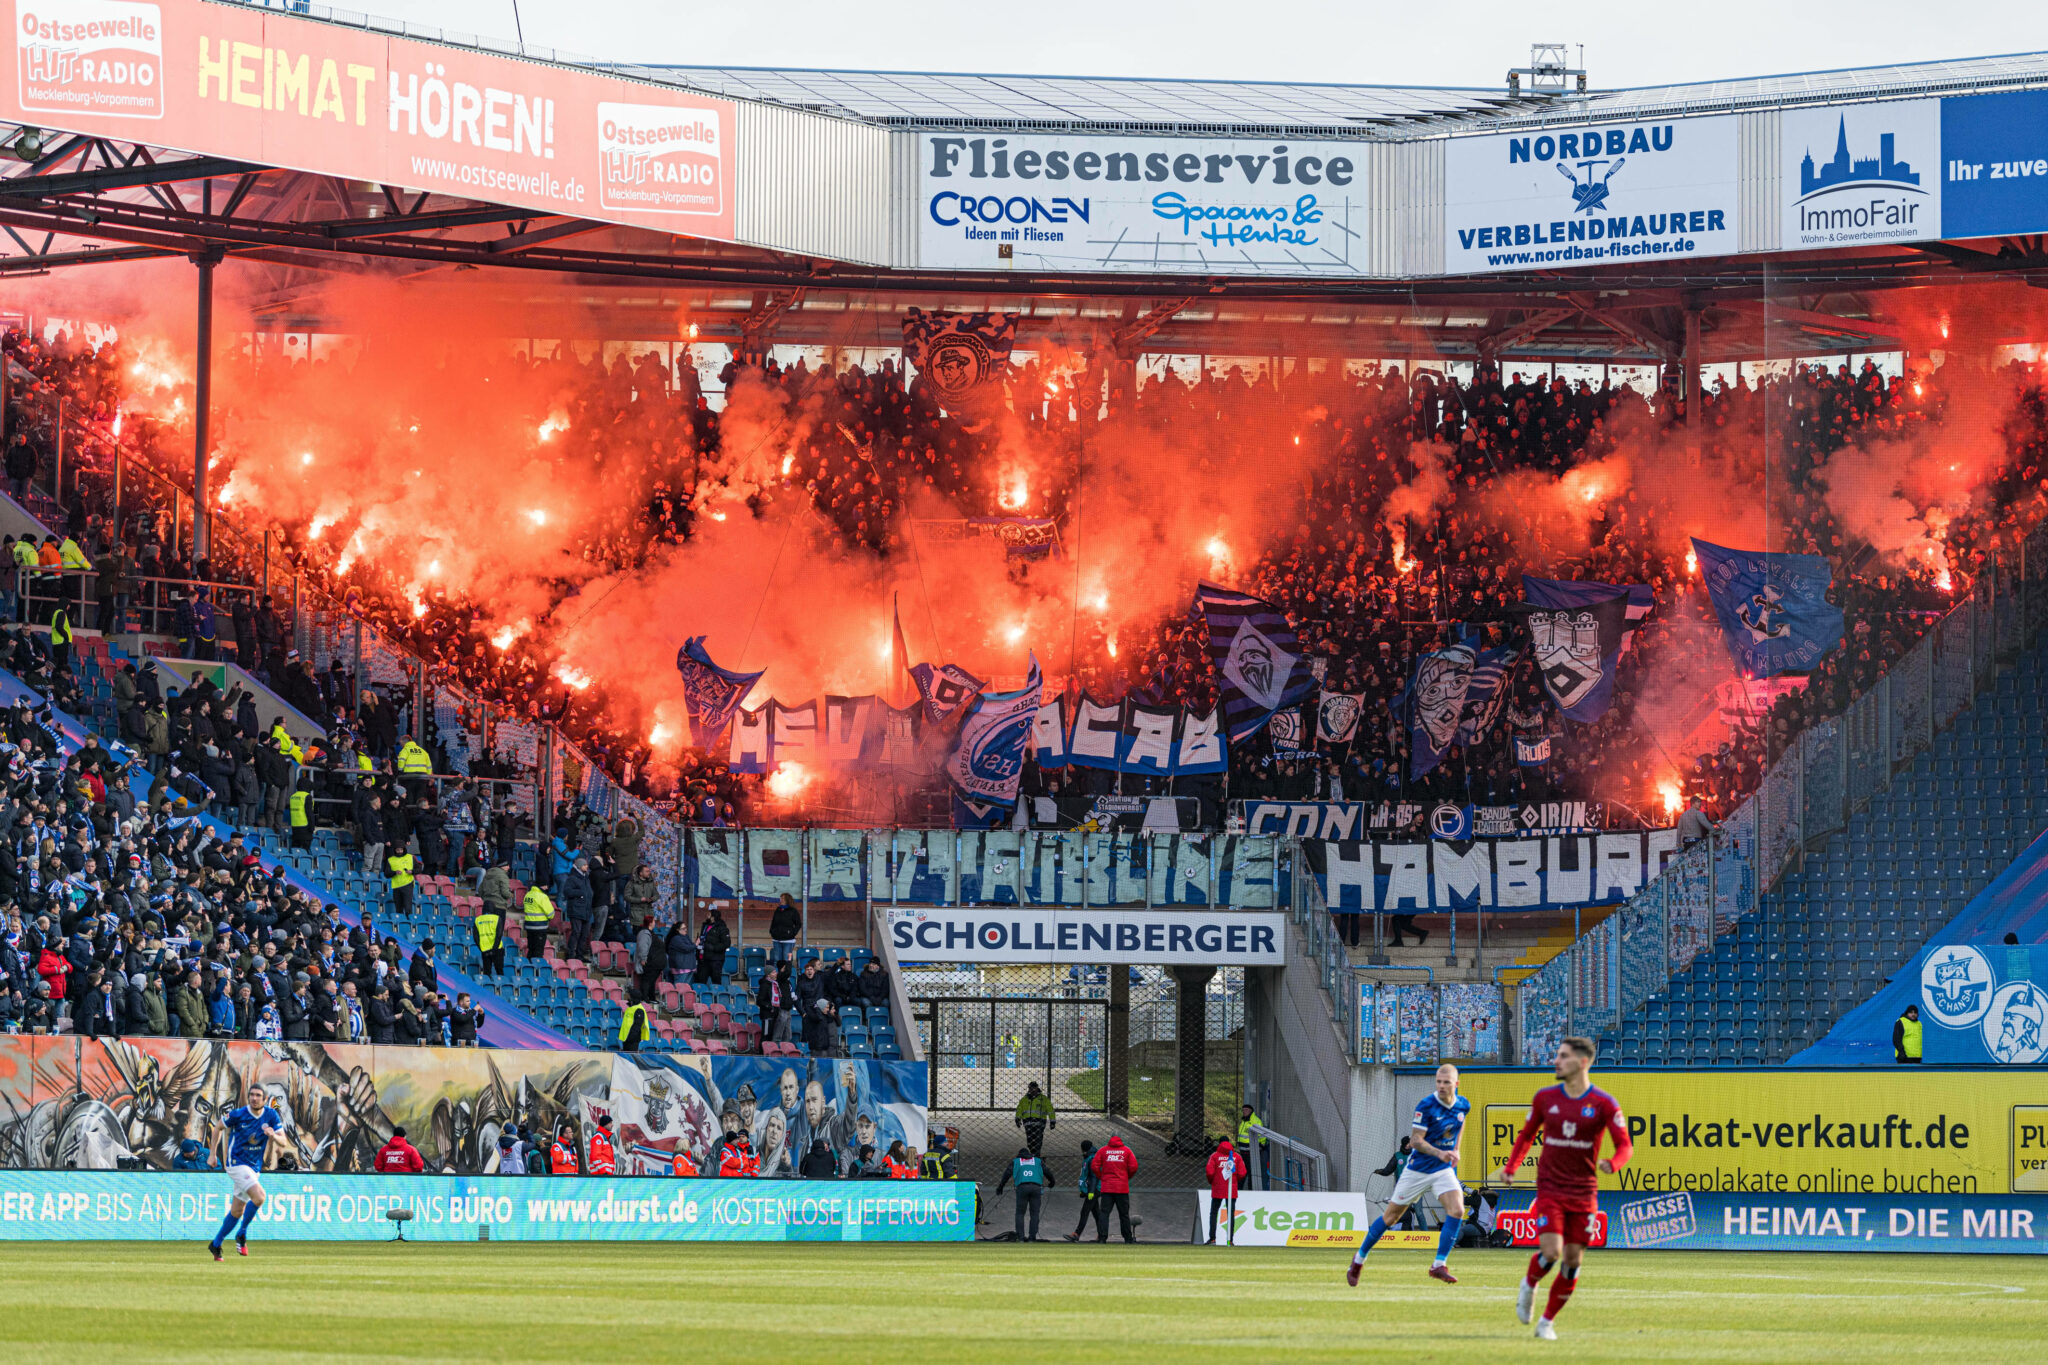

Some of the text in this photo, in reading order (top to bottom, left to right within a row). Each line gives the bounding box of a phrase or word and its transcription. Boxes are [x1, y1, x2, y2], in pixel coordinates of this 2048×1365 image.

[22, 12, 155, 41] Ostseewelle
[27, 43, 154, 86] HIT-RADIO
[28, 86, 154, 107] Mecklenburg-Vorpommern
[198, 35, 554, 159] HEIMAT HÖREN!
[602, 119, 715, 146] Ostseewelle
[1509, 125, 1673, 164] NORDBAU
[607, 147, 714, 185] HIT-RADIO
[929, 136, 1354, 186] Fliesenservice
[1948, 159, 1984, 182] Ihr
[411, 155, 585, 203] www.ostseewelle.de
[608, 187, 714, 205] Mecklenburg-Vorpommern
[930, 190, 1090, 227] CROONEN
[1152, 191, 1323, 236] Spaans &
[1458, 209, 1727, 250] VERBLENDMAURER
[1800, 197, 1920, 232] ImmoFair
[965, 226, 1064, 242] Ideen mit Fliesen
[1200, 221, 1319, 248] Henke
[1801, 228, 1918, 244] Wohn- & Gewerbeimmobilien
[1487, 238, 1695, 266] www.nordbau-fischer.de
[1541, 801, 1586, 828] IRON
[893, 920, 1276, 953] SCHOLLENBERGER
[1628, 1114, 1969, 1148] Plakat-verkauft.de
[1618, 1166, 1978, 1193] Werbeplakate online buchen
[0, 1192, 34, 1221] ER
[39, 1193, 90, 1221] APP
[96, 1192, 132, 1222] BIS
[138, 1193, 172, 1222] AN
[180, 1192, 218, 1222] DIE
[449, 1187, 513, 1223] BÜRO
[527, 1188, 698, 1223] www.durst.de
[712, 1197, 843, 1225] KOSTENLOSE
[847, 1198, 960, 1226] LIEFERUNG
[1252, 1206, 1354, 1231] team
[1626, 1195, 1686, 1224] KLASSE
[1630, 1214, 1689, 1245] WURST
[1723, 1206, 2035, 1241] HEIMAT, DIE MIR
